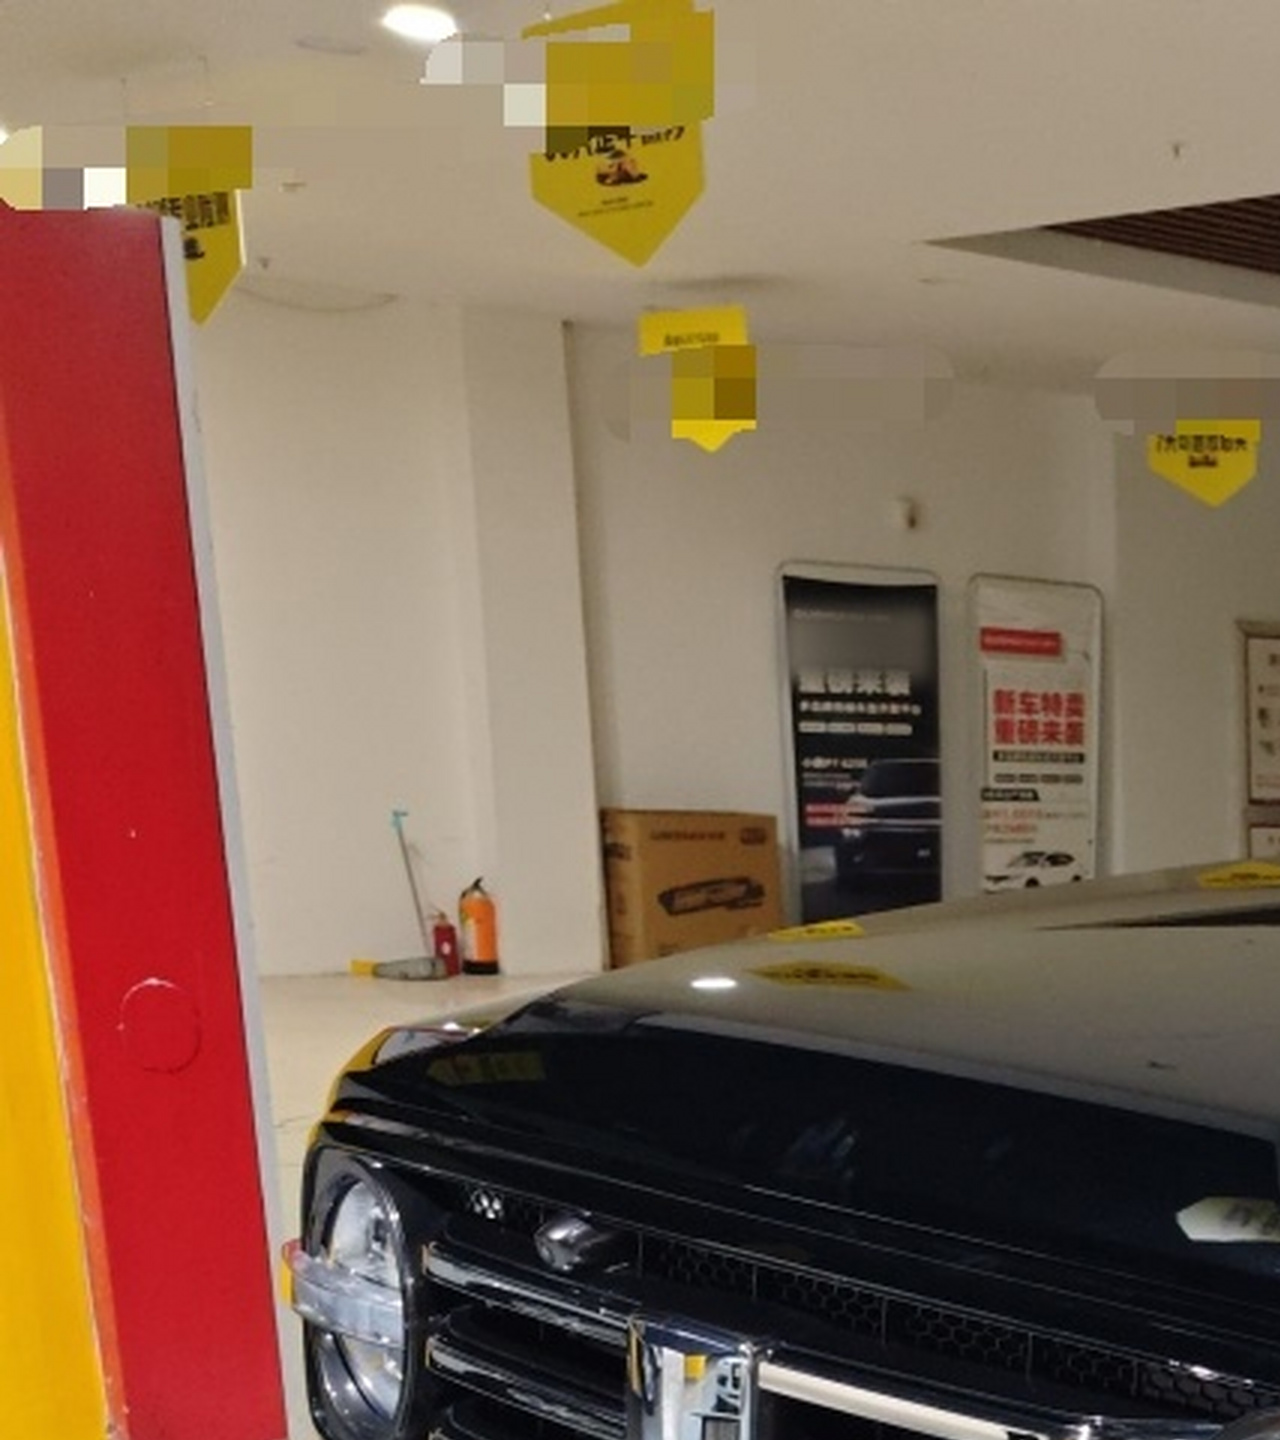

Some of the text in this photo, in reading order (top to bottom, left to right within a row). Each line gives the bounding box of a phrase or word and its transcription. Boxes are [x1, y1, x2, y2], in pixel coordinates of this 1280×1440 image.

[993, 689, 1085, 718] 新车特卖
[993, 719, 1085, 745] 重磅来袭
